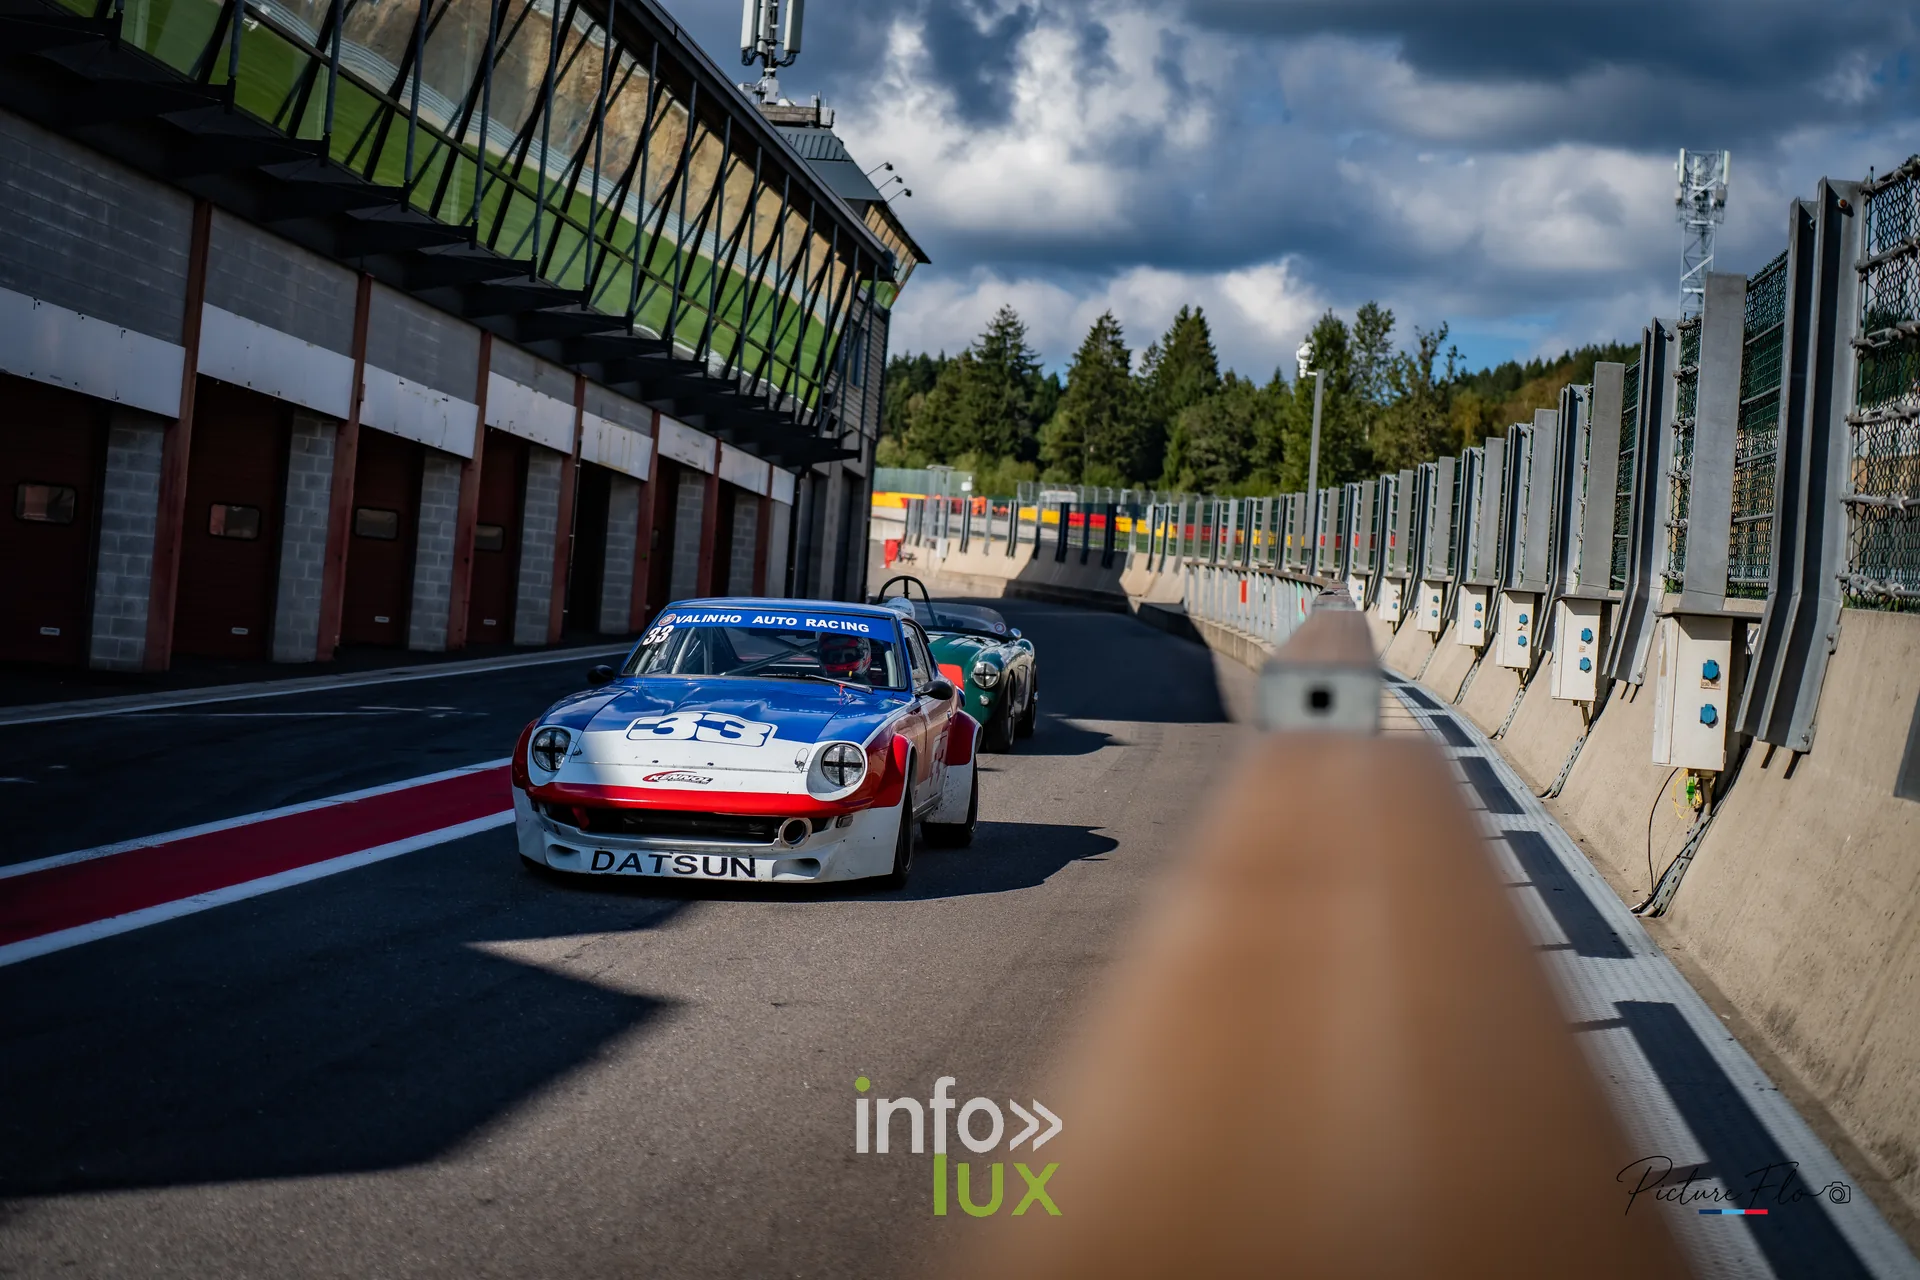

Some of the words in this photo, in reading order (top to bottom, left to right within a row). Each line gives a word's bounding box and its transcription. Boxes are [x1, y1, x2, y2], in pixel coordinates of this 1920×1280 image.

[643, 625, 675, 646] 33
[675, 614, 742, 624] VALINHO
[752, 615, 798, 626] AUTO
[806, 618, 870, 633] RACING
[626, 712, 774, 747] 33
[591, 850, 756, 878] DATSUN
